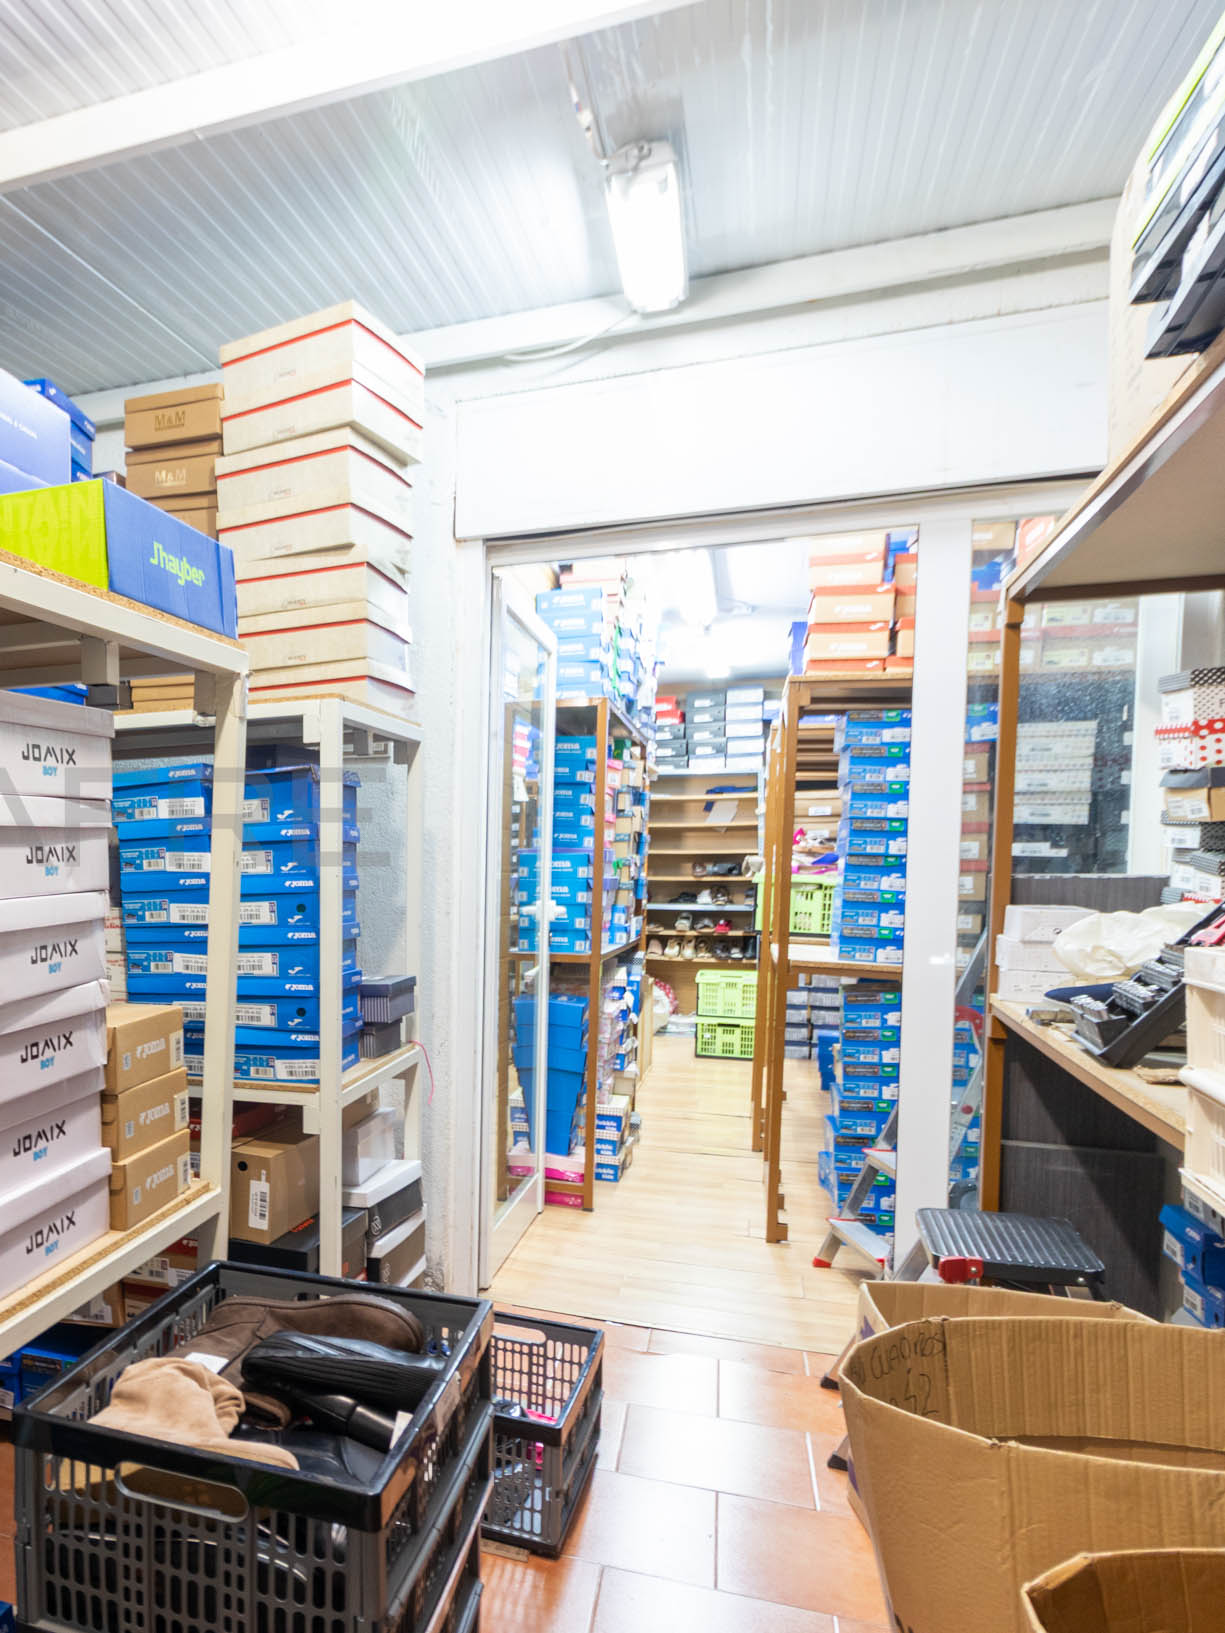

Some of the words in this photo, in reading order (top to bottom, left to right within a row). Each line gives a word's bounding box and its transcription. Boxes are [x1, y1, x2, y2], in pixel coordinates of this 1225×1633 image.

[22, 744, 76, 765] JOMIX
[42, 766, 57, 776] BOY
[27, 846, 76, 864] JOMIX
[45, 866, 58, 876] BOY
[30, 939, 78, 965] JOMIX
[48, 962, 62, 974] BOY
[20, 1031, 73, 1063] JOMIX
[40, 1056, 55, 1070] BOY
[13, 1120, 66, 1157] JOMIX
[33, 1147, 48, 1161] BOY
[26, 1211, 76, 1254] JOMIX
[45, 1240, 59, 1256] BOY
